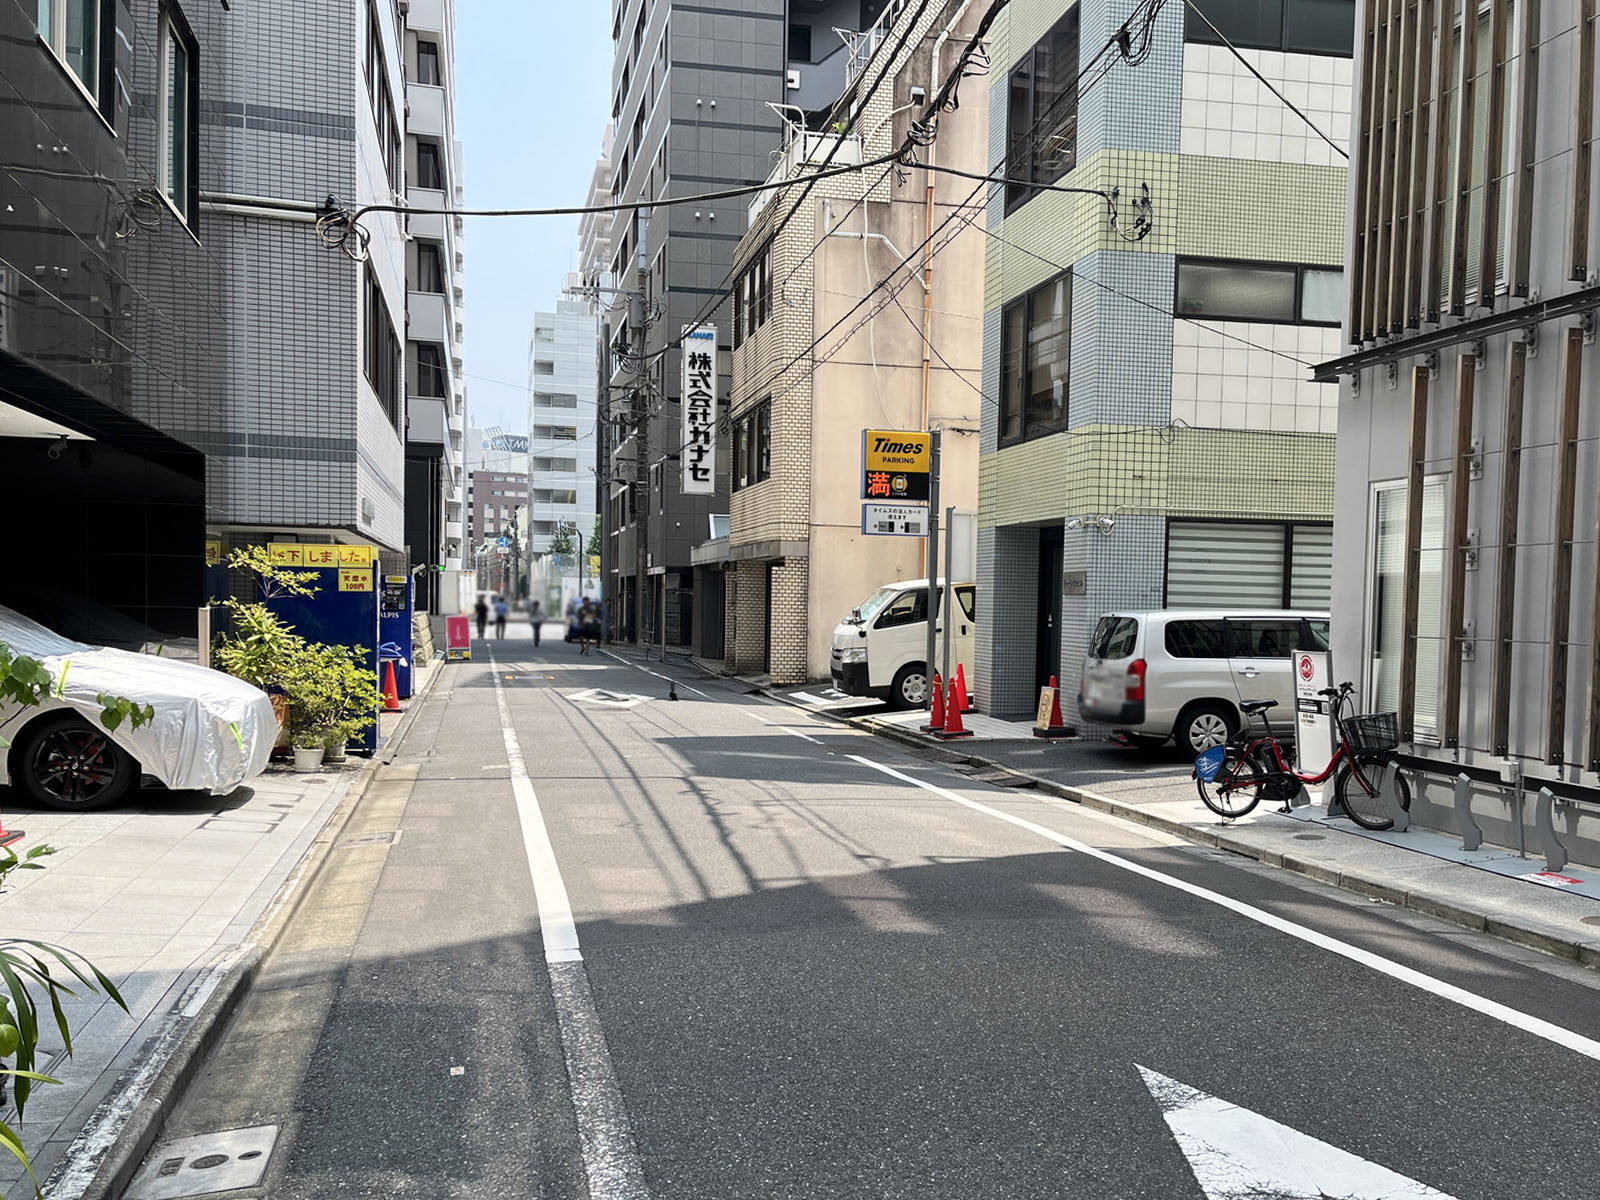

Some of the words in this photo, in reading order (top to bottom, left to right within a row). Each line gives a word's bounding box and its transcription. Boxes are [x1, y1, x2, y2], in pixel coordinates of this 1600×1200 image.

[687, 352, 712, 482] 株式会社カナセ
[874, 438, 923, 454] Times
[868, 472, 890, 497] 満
